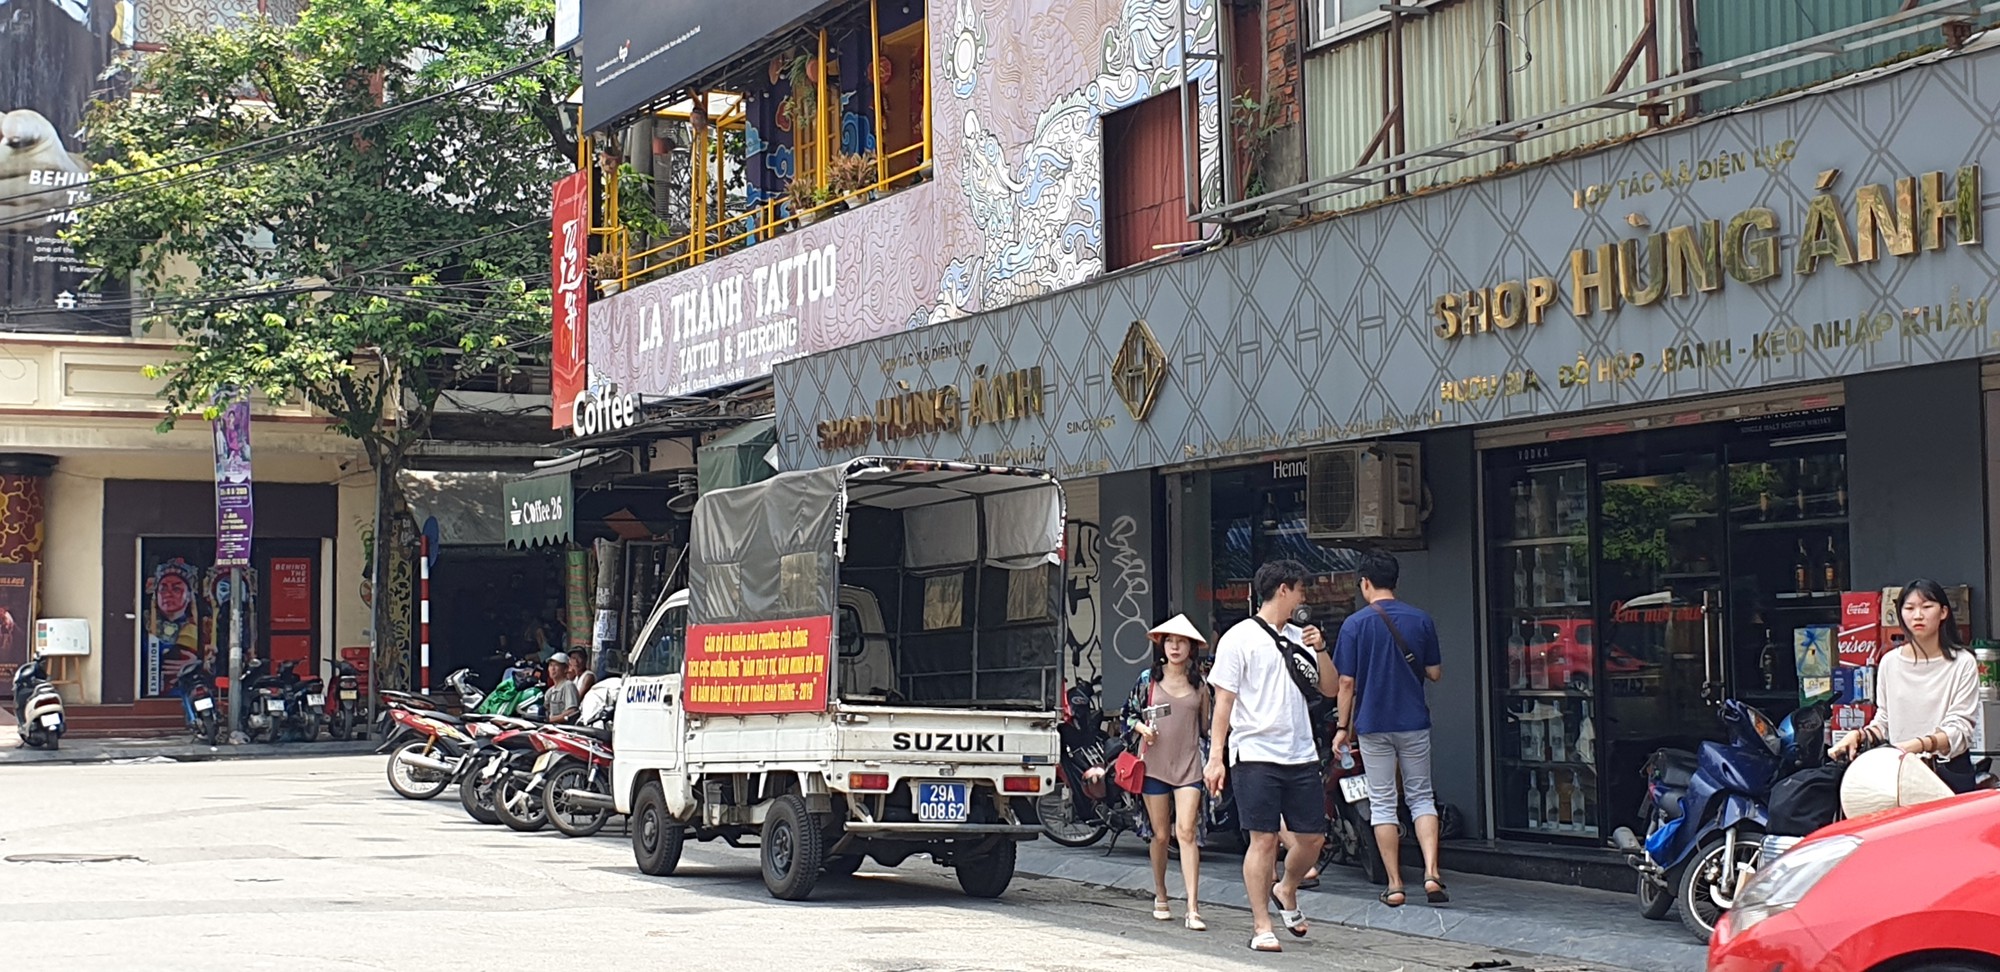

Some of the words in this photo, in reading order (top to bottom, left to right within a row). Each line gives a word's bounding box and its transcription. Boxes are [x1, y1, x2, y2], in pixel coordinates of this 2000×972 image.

[29, 169, 90, 188] BEHIN
[1432, 276, 1560, 340] SHOP
[1570, 207, 1782, 317] HÙNG
[1795, 164, 1982, 274] ÁNH
[638, 301, 664, 354] LA
[669, 275, 744, 343] THÀNH
[752, 243, 837, 318] TATTOO
[679, 339, 719, 376] TATTOO
[723, 335, 734, 365] &
[736, 316, 798, 362] PIERCING
[1502, 369, 1541, 397] BIA
[1662, 333, 1733, 373] BÁNH
[1752, 326, 1806, 363] KẸO
[572, 384, 634, 437] Coffee
[817, 415, 873, 451] SHOP
[875, 378, 960, 442] HÙNG
[968, 363, 1045, 426] ÁNH
[1066, 419, 1092, 434] SINCE
[1518, 447, 1549, 460] VODKA
[1273, 460, 1308, 479] Henne
[523, 499, 550, 524] Coffee
[551, 495, 562, 520] 26
[275, 563, 306, 571] BEHIND
[1293, 656, 1317, 686] adida
[626, 678, 648, 703] CẢNH
[647, 679, 664, 702] SÁT
[893, 732, 1004, 752] SUZUKI
[930, 785, 955, 802] 29A
[920, 803, 965, 819] 008.62
